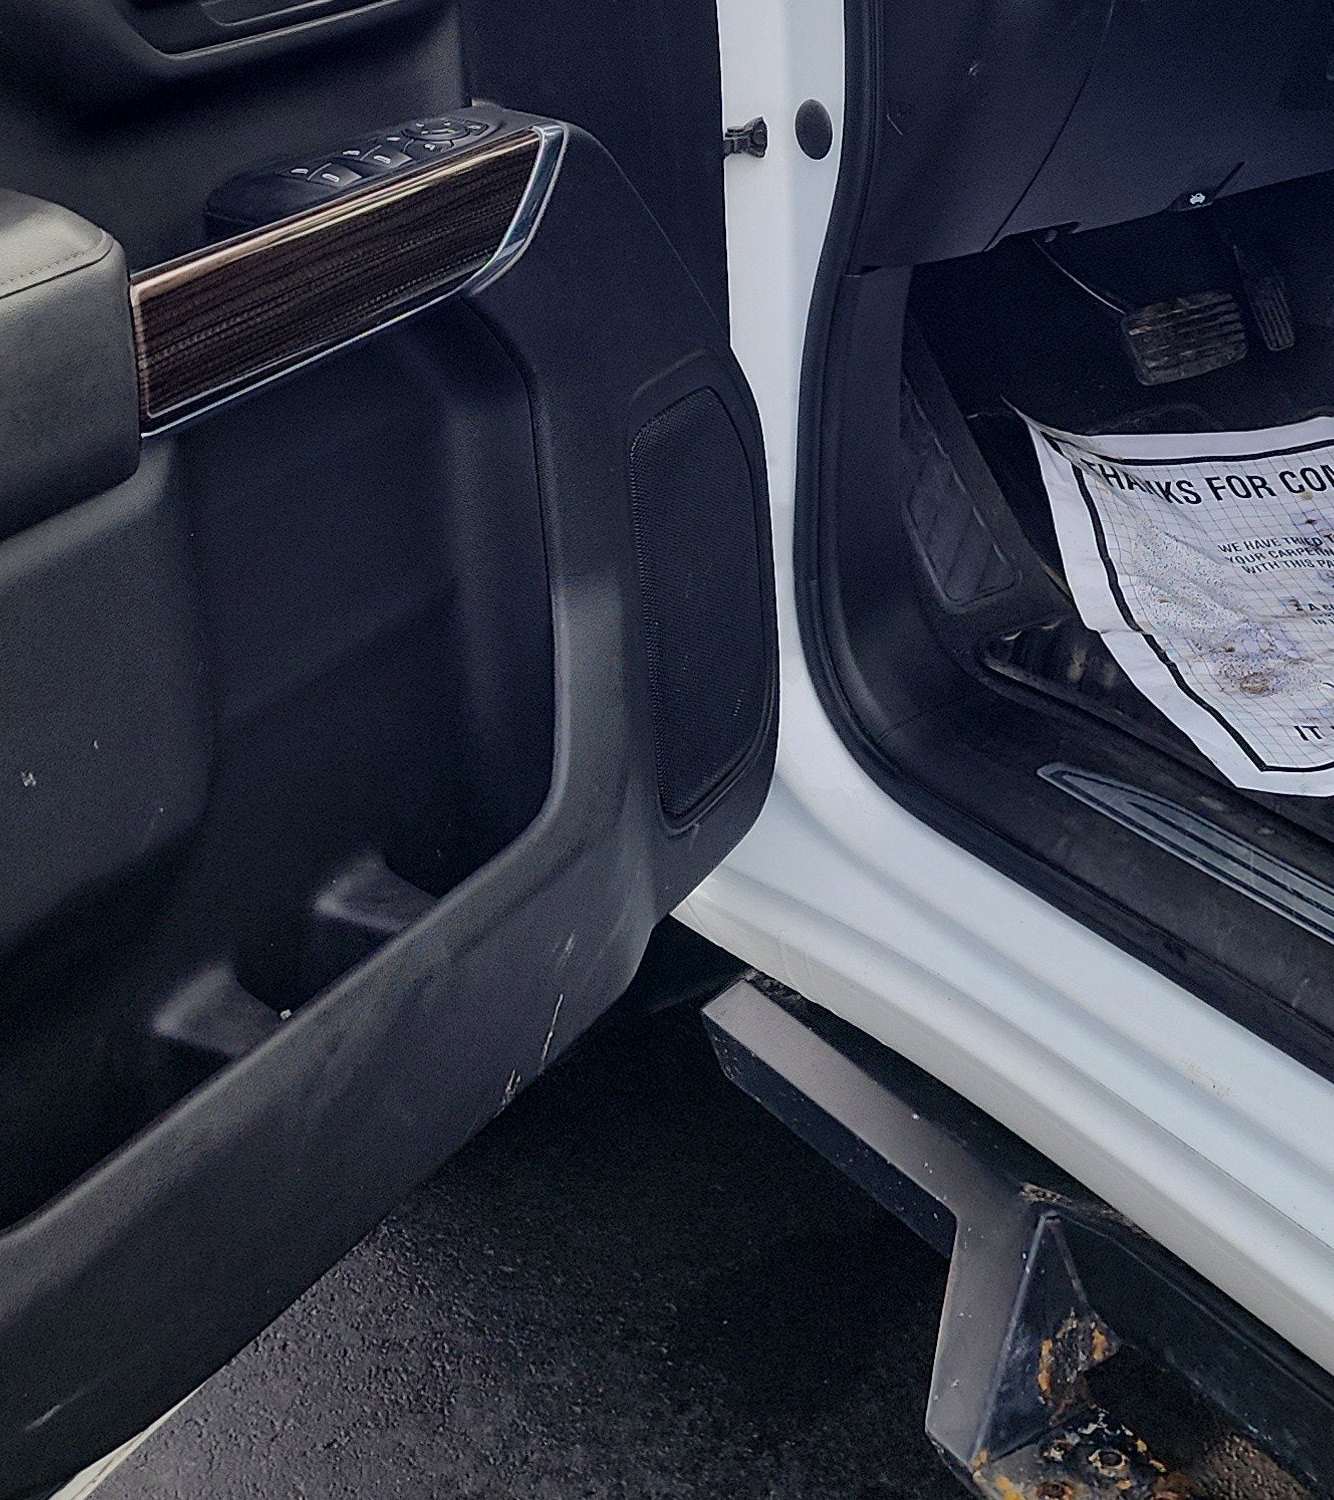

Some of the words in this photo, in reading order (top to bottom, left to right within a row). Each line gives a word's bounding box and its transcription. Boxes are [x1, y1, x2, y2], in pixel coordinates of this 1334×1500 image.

[1206, 474, 1276, 502] FOR
[1217, 541, 1242, 553] WE
[1243, 537, 1282, 551] HAVE
[1224, 552, 1266, 565] YOUR
[1240, 561, 1281, 575] WITH
[1281, 559, 1316, 569] THIS
[1293, 725, 1324, 742] IT
